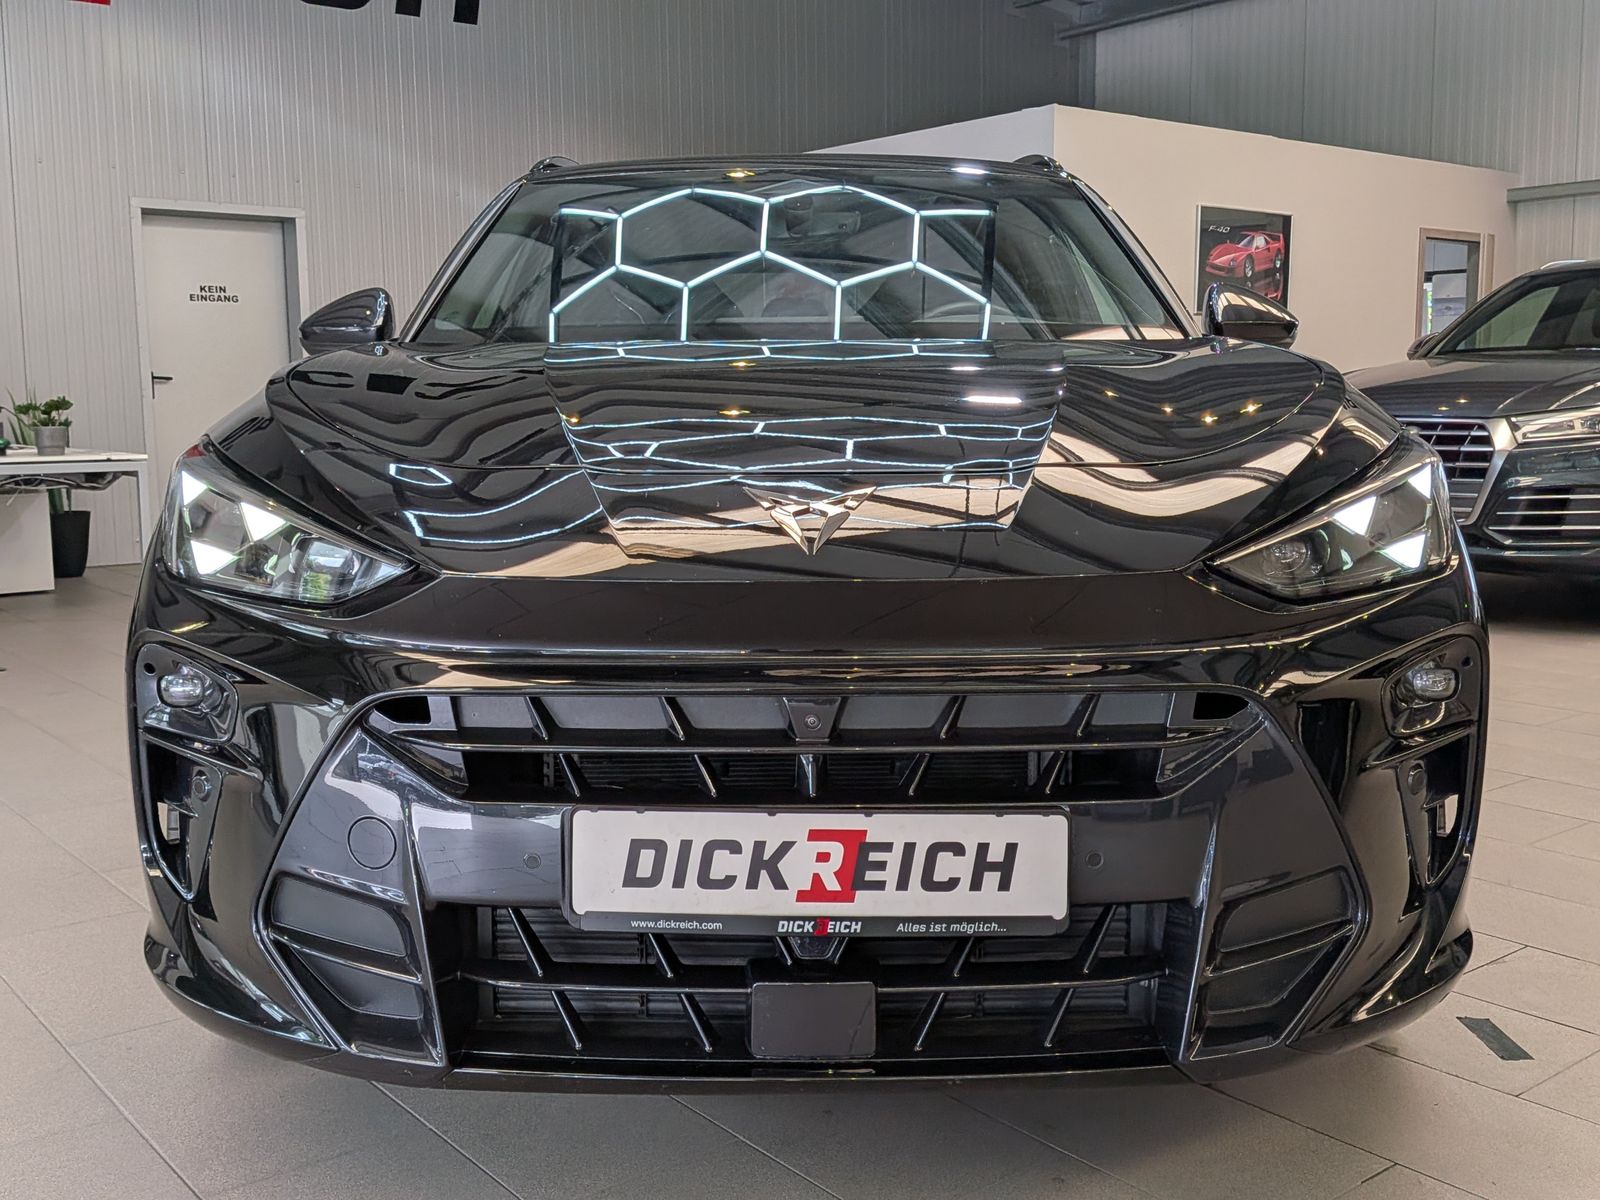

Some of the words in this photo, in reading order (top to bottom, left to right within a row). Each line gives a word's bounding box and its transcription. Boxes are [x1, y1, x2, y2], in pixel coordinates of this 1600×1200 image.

[199, 285, 227, 294] KEIN
[189, 294, 239, 303] EINGANG
[622, 829, 1019, 903] DICKREICH
[630, 919, 723, 931] www.dickreich.com
[896, 922, 926, 933] Alles
[929, 922, 947, 933] ist
[950, 922, 1007, 934] möglich...
